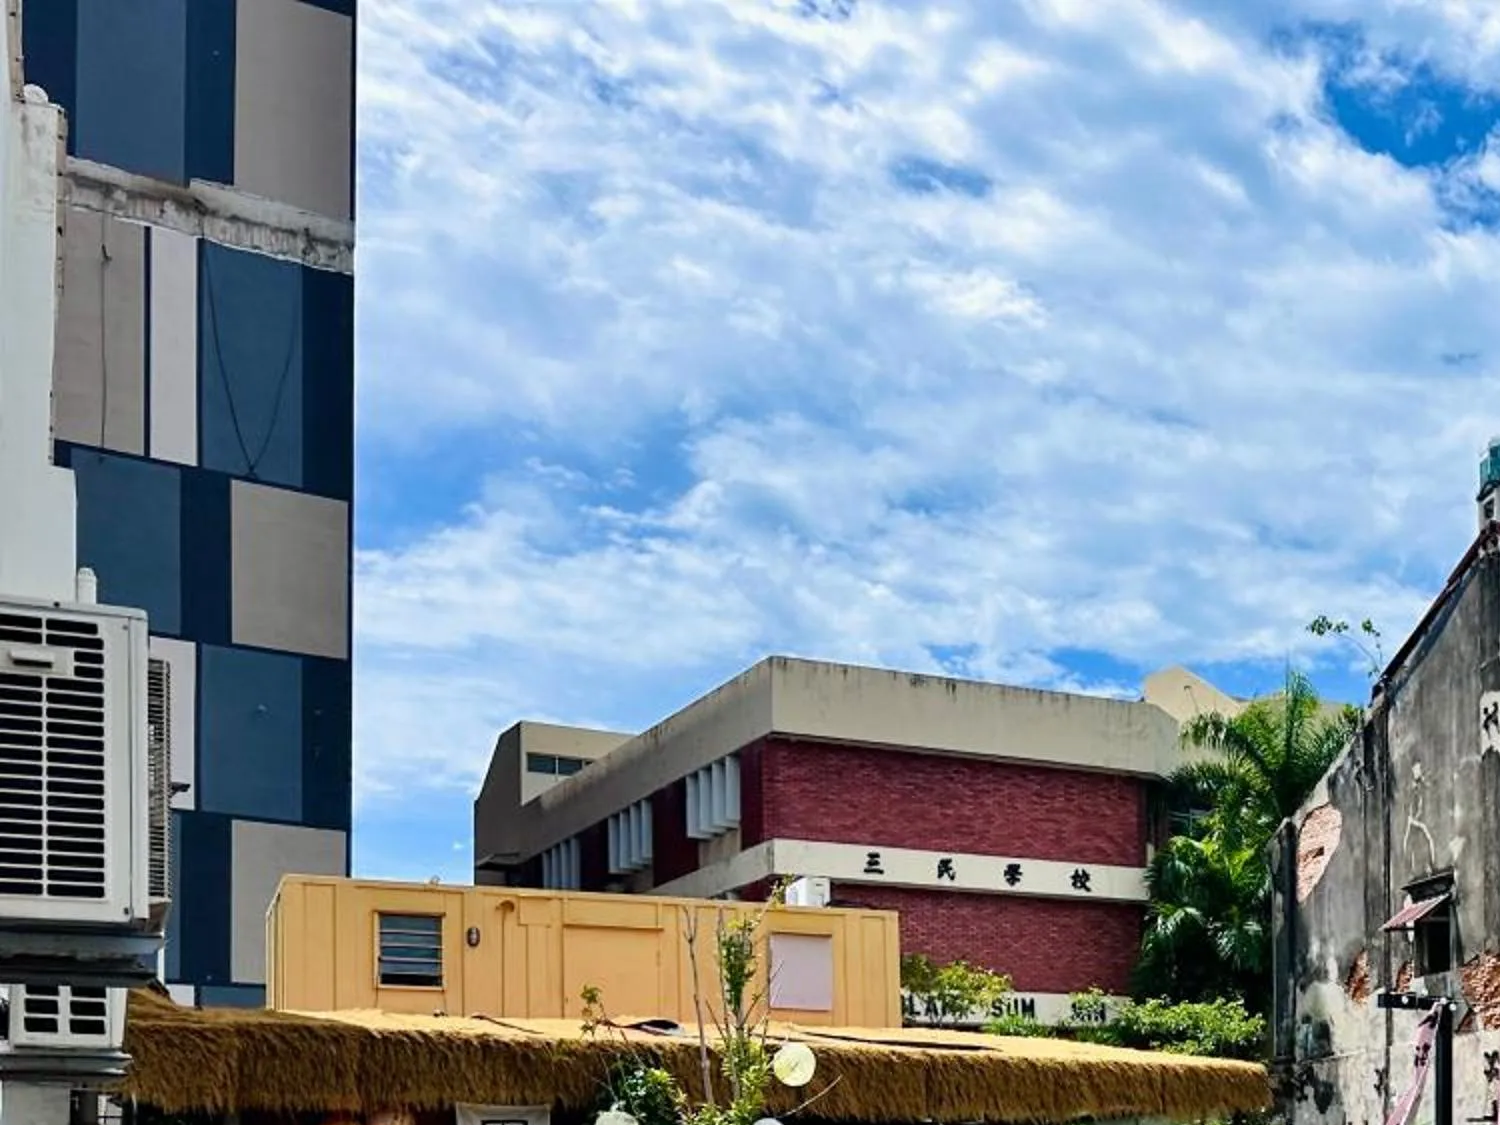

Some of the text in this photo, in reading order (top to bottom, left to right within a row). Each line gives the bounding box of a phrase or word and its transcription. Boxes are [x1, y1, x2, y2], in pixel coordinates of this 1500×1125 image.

[864, 852, 1092, 893] 三民學校
[990, 996, 1036, 1019] SUM
